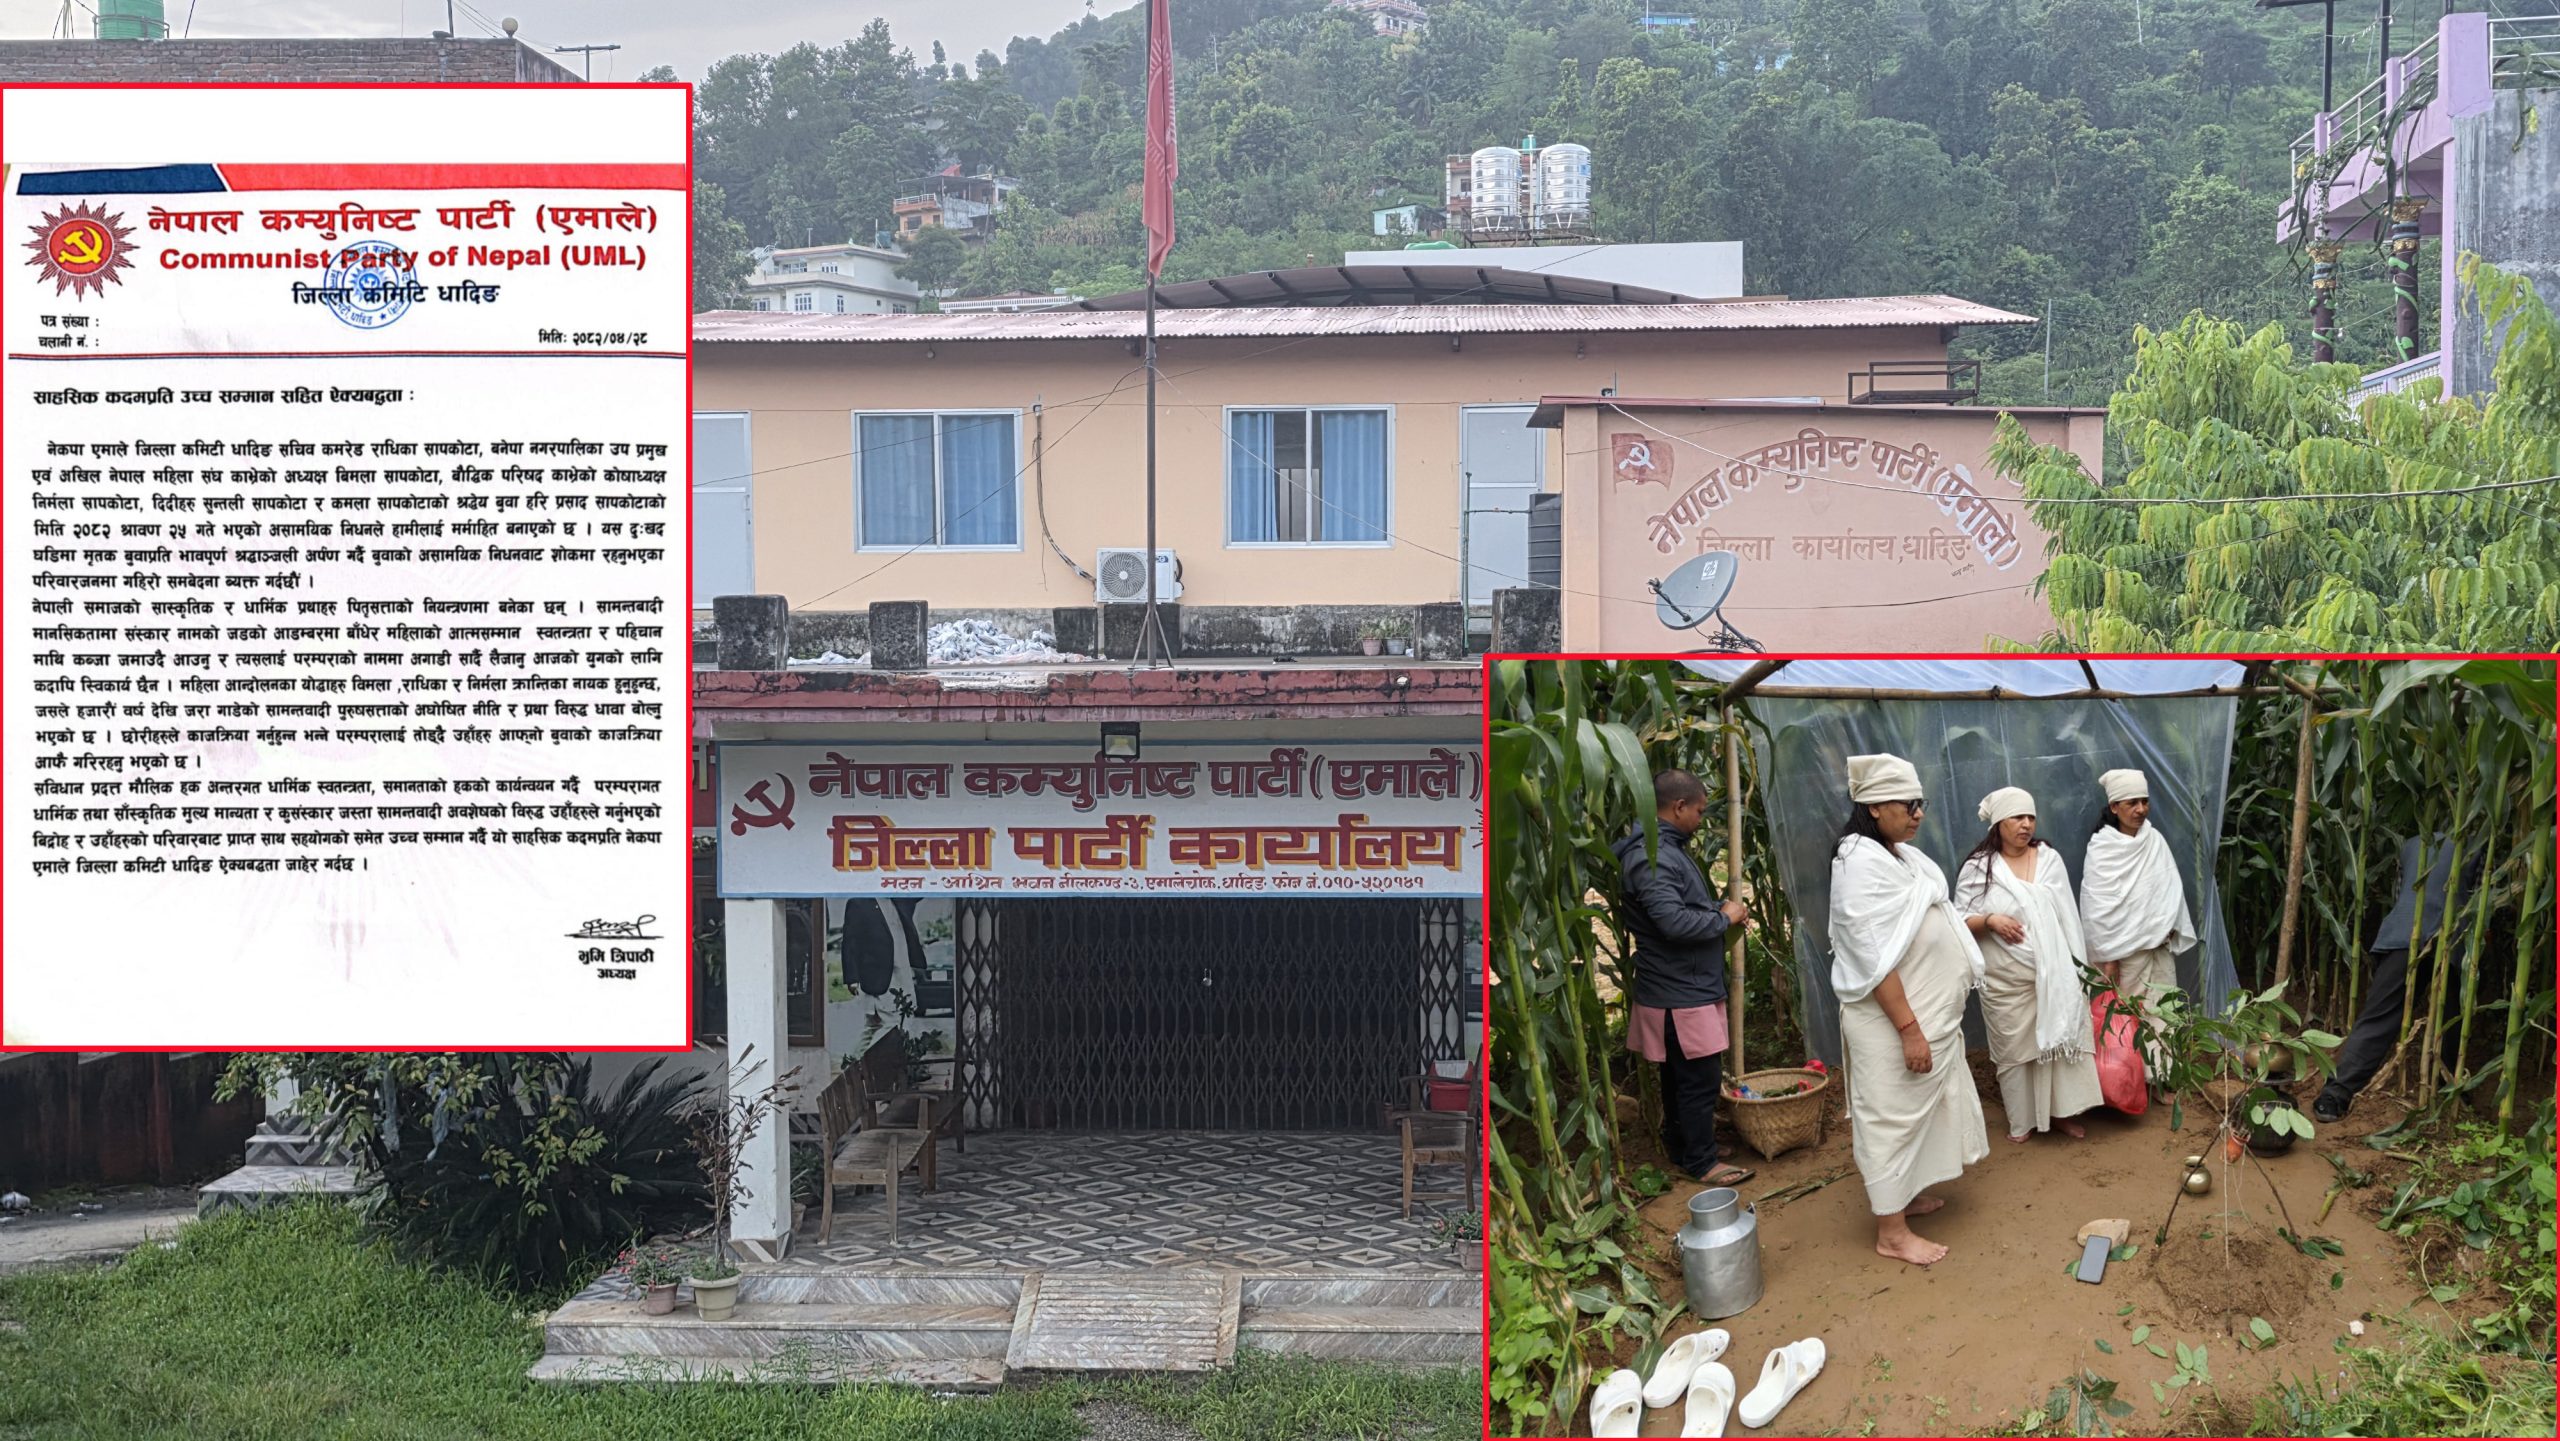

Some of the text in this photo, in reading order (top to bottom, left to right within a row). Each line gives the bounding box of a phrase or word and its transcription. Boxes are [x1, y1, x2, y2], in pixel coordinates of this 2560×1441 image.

[149, 200, 656, 240] नेपाल कम्युनिष्ट पार्टी (एमाले)
[160, 245, 646, 272] Communist Party of Nepal (UML)
[292, 282, 501, 306] जिल्ला कमिटि धादिङ
[40, 315, 58, 327] पत्र
[62, 314, 90, 329] संख्या
[39, 334, 72, 348] चलानी
[573, 333, 647, 346] २०८२/०४/२८
[33, 387, 100, 406] साहसिक
[104, 386, 175, 406] कदमप्रति
[180, 390, 213, 404] उच्च
[218, 390, 275, 404] सम्मान
[280, 386, 324, 404] सहित
[329, 386, 403, 406] ऐक्यबद्धता
[48, 438, 668, 461] नेकपा एमाले जिल्ला कमिटी धादिङ सचिव कमरेड राधिका सापकोटा, बनेपा नगरपालिका उप प्रमुख
[32, 467, 52, 485] एवं
[60, 465, 102, 483] अखिल
[109, 467, 145, 484] नेपाल
[153, 466, 194, 485] महिला
[201, 468, 223, 484] संघ
[285, 470, 328, 484] अध्यक्ष
[335, 466, 377, 484] बिमला
[384, 466, 442, 485] सापकोटा,
[501, 465, 544, 484] परिषद
[604, 466, 667, 484] कोषाध्यक्ष
[32, 491, 666, 514] निर्मला सापकोटा, दिदीहरु सुन्तली सापकोटा र कमला सापकोटाको श्रद्धेय बुवा हरि प्रसाद सापकोटाको
[1647, 428, 2022, 570] नेपाल कम्युनिष्ट पार्टी (एमाले)
[34, 519, 65, 536] मिति
[73, 524, 110, 539] २०८२
[121, 524, 161, 536] श्रावण
[169, 525, 186, 539] २५
[195, 521, 216, 537] गते
[223, 521, 262, 539] भएको
[269, 519, 333, 537] असामयिक
[340, 519, 385, 537] निधनले
[392, 519, 444, 538] हामीलाई
[451, 518, 499, 537] मर्माहित
[506, 519, 556, 538] बनाएको
[563, 522, 577, 536] छ
[601, 523, 623, 536] यस
[33, 545, 77, 562] घडिमा
[83, 550, 118, 566] मृतक
[124, 546, 172, 566] बुवाप्रति
[179, 546, 228, 566] भावपूर्ण
[306, 546, 340, 562] अर्पण
[346, 545, 366, 563] गर्दै
[371, 546, 412, 566] बुवाको
[419, 545, 482, 562] असामयिक
[551, 545, 596, 562] शोकमा
[602, 549, 664, 565] रहनुभएका
[32, 571, 117, 589] परिवारजनमा
[123, 571, 161, 590] गहिरो
[32, 597, 73, 615] नेपाली
[84, 599, 141, 615] समाजको
[223, 601, 236, 617] र
[297, 601, 337, 616] प्रथाहरु
[423, 597, 489, 613] नियन्त्रणमा
[498, 598, 534, 613] बनेका
[544, 601, 567, 616] छन्
[32, 622, 663, 642] मानसिकतामा संस्कार नामको जडको आडम्बरमा बाँधेर महिलाको आत्मसम्मान स्वतन्त्रता र पहिचान
[808, 752, 953, 799] नेपाल
[963, 751, 1200, 812] कम्युनिष्ट
[1207, 747, 1308, 800] पार्टी
[827, 813, 1467, 872] जिल्ला पार्टी कार्यालय
[610, 947, 655, 964] त्रिपाठी
[597, 968, 637, 981] अध्यक्ष
